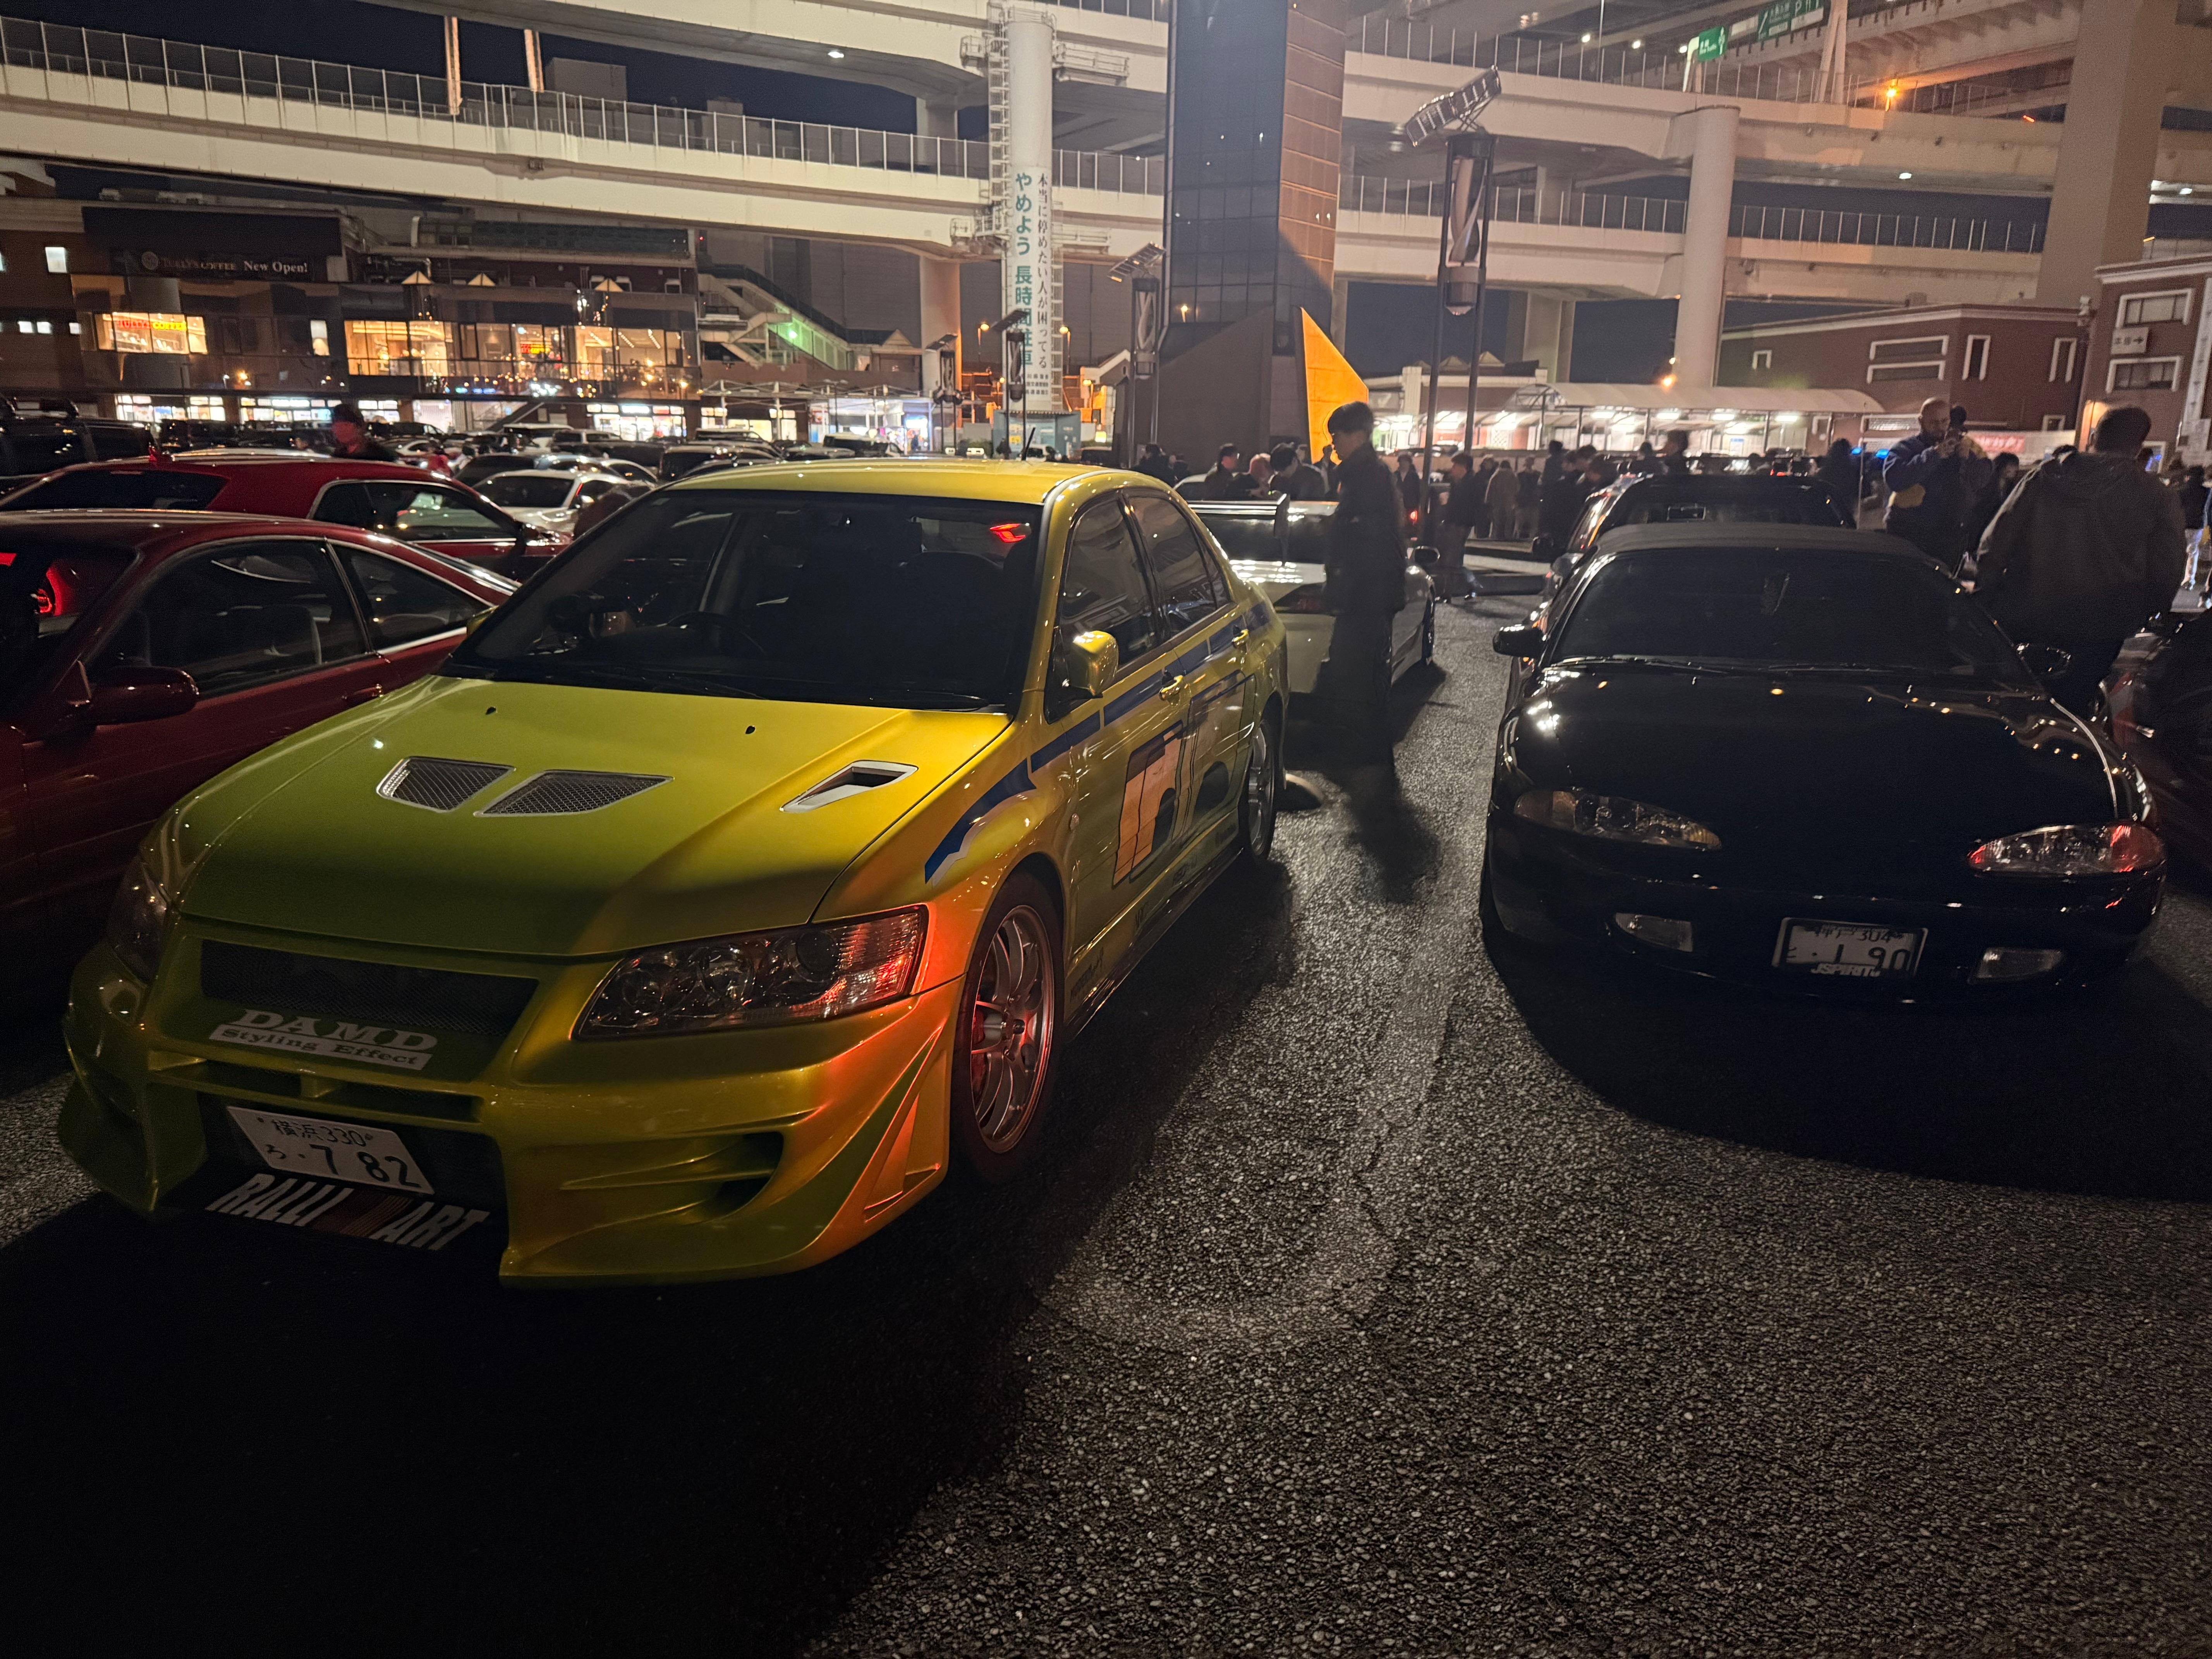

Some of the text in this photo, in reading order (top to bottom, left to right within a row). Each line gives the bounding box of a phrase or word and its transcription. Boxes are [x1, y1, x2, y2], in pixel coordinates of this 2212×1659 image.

[1015, 172, 1032, 256] やめよう
[244, 260, 269, 271] New
[272, 261, 308, 275] Open!
[222, 1028, 421, 1065] Styling Effect
[228, 1008, 438, 1051] DAMD
[368, 1201, 490, 1251] ART
